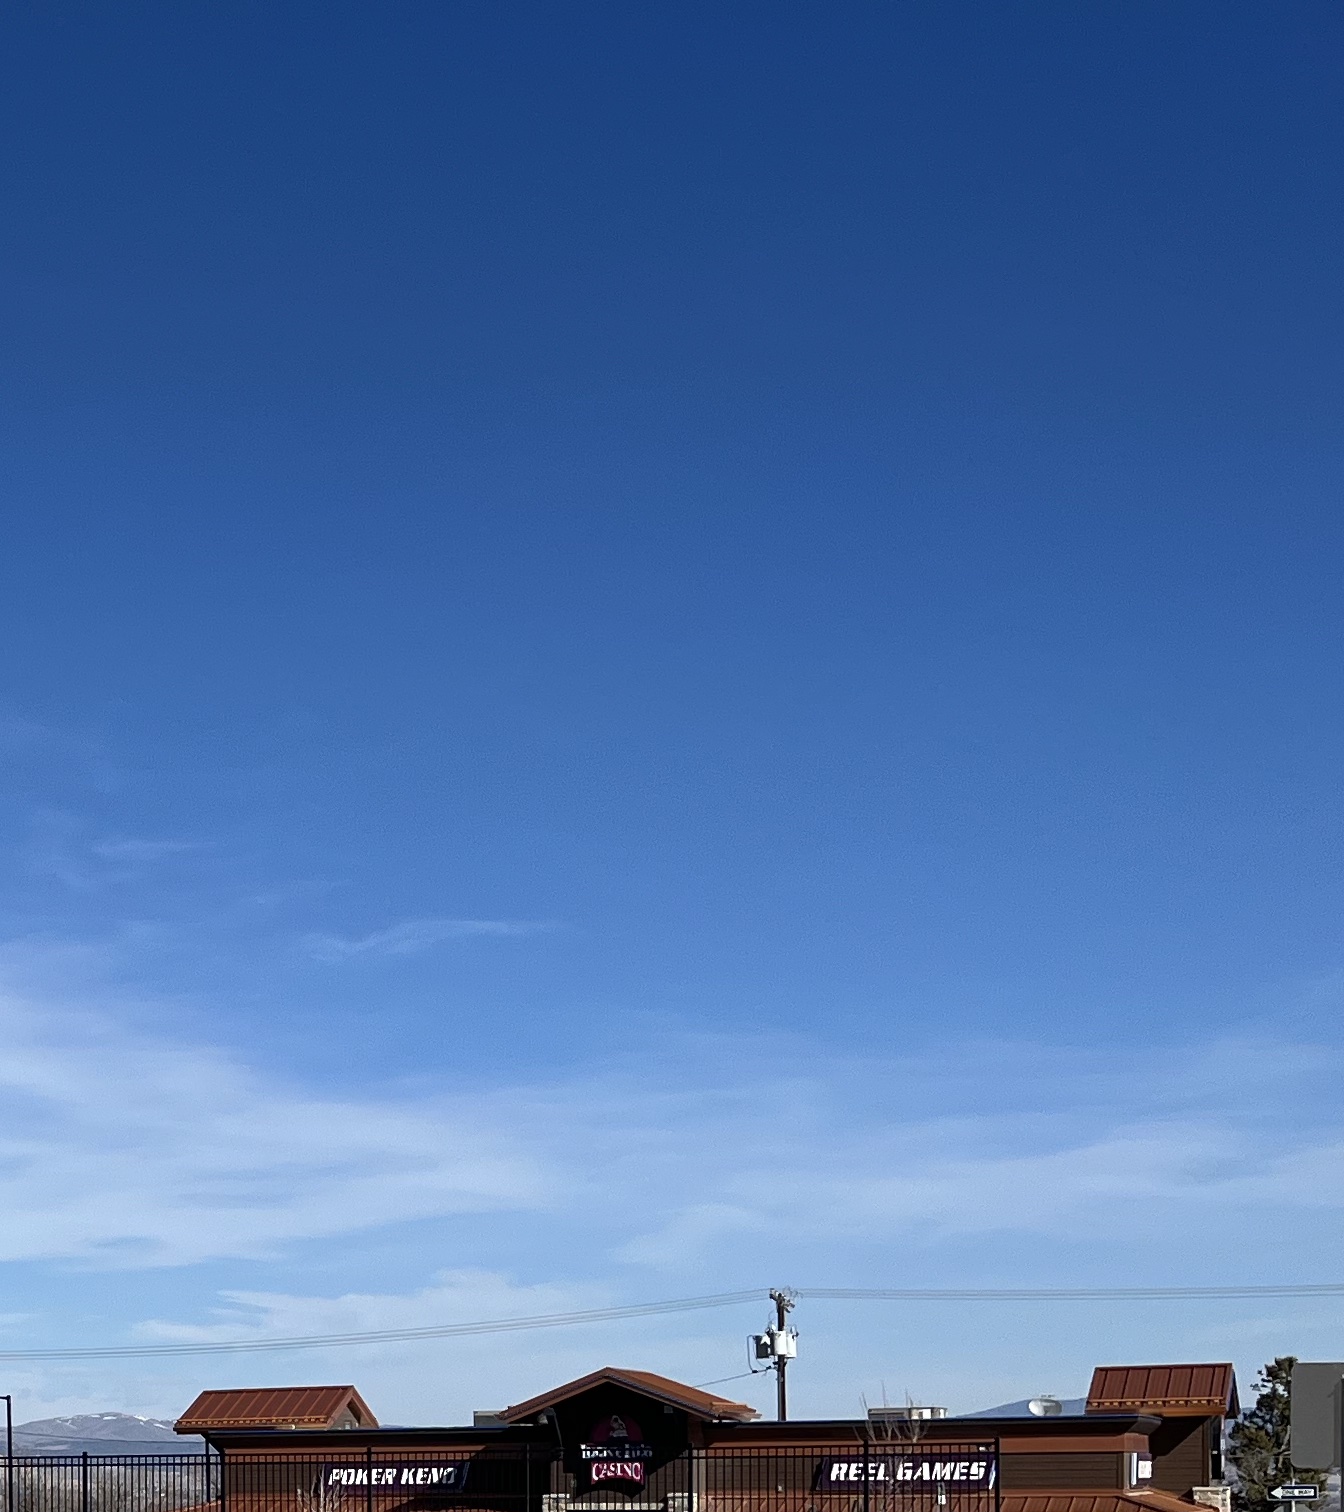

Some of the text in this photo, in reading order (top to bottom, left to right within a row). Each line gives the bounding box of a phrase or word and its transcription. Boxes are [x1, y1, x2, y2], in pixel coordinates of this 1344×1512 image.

[328, 1467, 457, 1485] POKER KENO
[592, 1462, 641, 1480] CASINO
[830, 1461, 987, 1481] REEL GAMES
